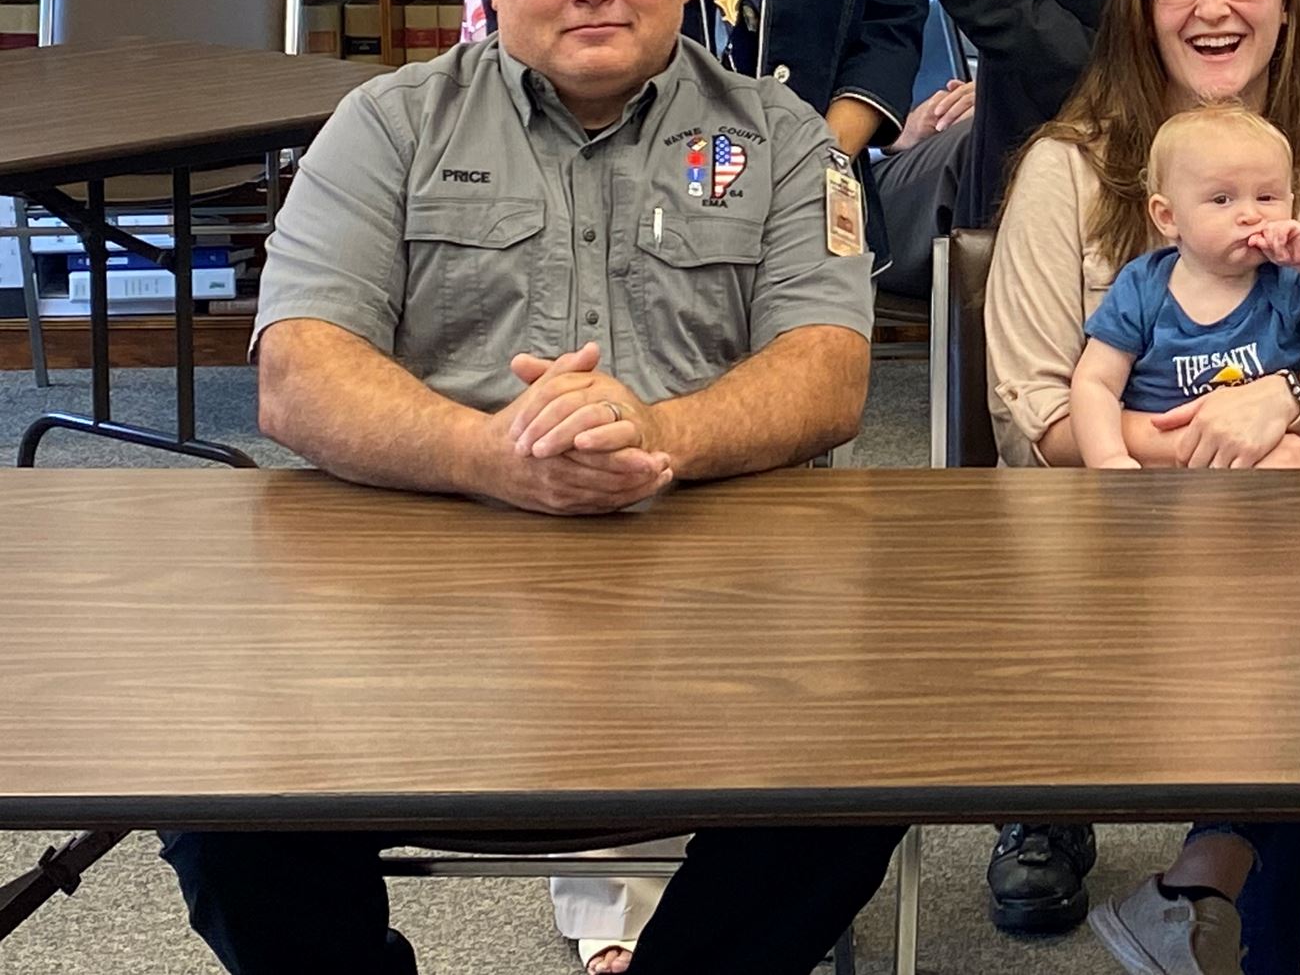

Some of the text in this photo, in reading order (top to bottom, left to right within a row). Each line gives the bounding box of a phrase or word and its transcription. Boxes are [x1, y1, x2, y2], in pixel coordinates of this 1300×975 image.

[664, 126, 766, 146] WAYNE COUNTY
[443, 169, 491, 183] PRICE
[702, 199, 728, 208] EMA
[1173, 355, 1211, 387] THE
[1211, 343, 1264, 375] SALTY
